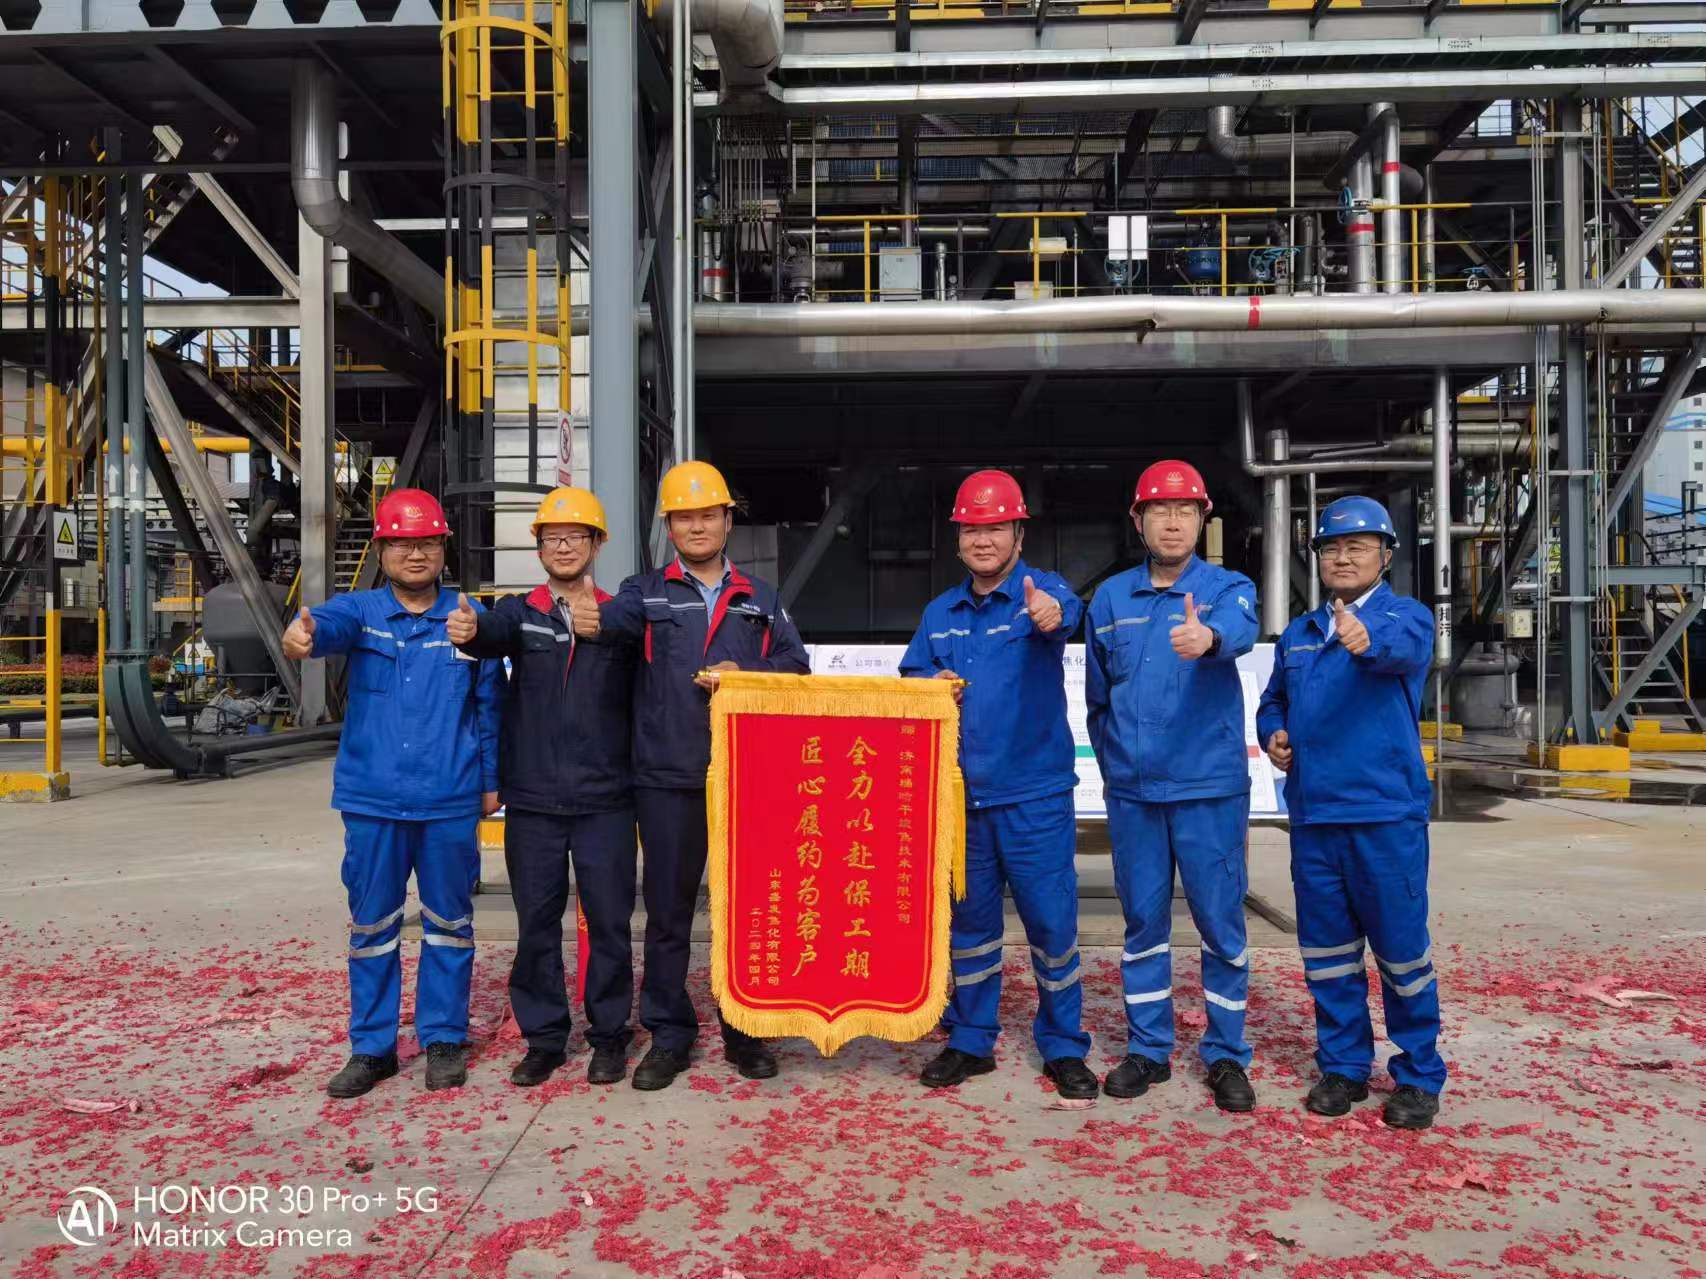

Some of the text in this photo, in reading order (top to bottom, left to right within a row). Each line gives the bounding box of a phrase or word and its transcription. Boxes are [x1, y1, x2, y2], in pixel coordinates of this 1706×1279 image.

[791, 736, 826, 976] 匠心履约为客户
[840, 736, 878, 979] 全力以赴保工期
